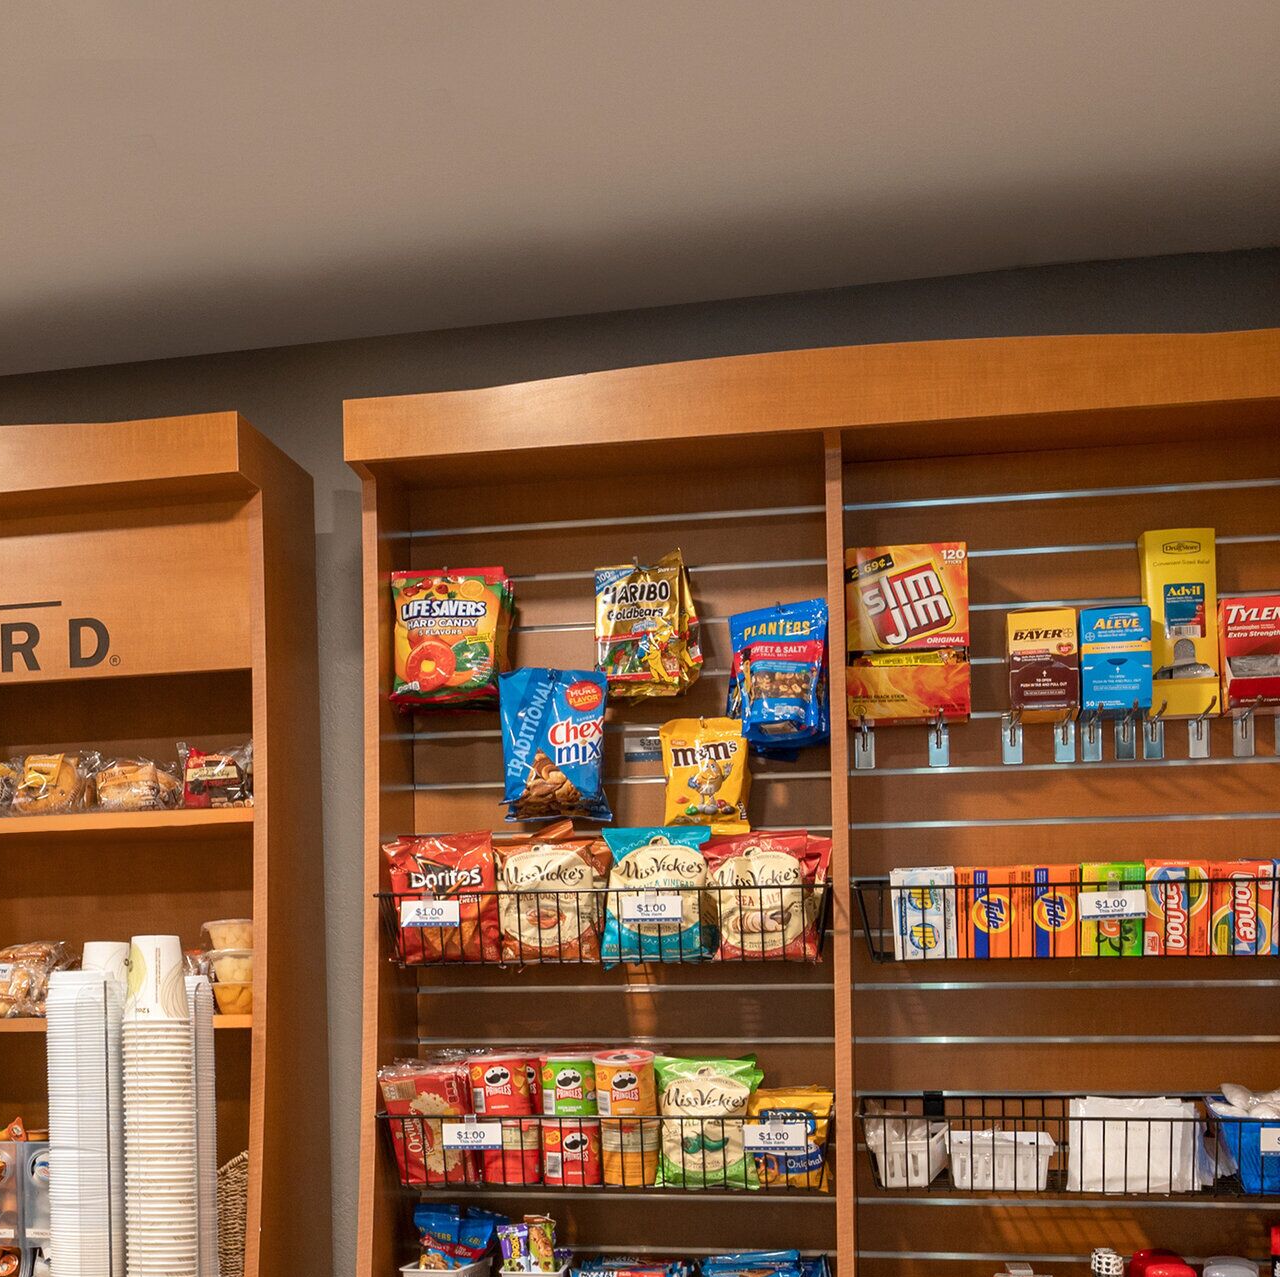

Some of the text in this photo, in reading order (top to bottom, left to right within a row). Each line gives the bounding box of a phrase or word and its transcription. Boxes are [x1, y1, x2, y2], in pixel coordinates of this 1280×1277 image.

[941, 549, 965, 560] 120
[604, 580, 671, 605] HARIBO
[1167, 585, 1201, 596] Advil
[607, 607, 665, 621] Goldbears
[407, 619, 478, 629] HARD CANDY
[1093, 618, 1140, 630] ALEVE
[744, 621, 811, 641] PLANTERS
[1013, 629, 1063, 641] BAYER
[1227, 630, 1280, 639] Extra Strength
[783, 644, 808, 653] SALTY
[569, 695, 600, 705] FLAVOR
[507, 681, 554, 778] TRADITIONAL
[549, 716, 605, 746] Chex
[556, 737, 603, 766] mix
[671, 741, 738, 767] m&m's
[620, 854, 705, 880] Miss Vickie's
[410, 868, 482, 888] Doritos
[717, 863, 800, 887] Miss Vickie's
[734, 894, 755, 906] SEA
[1095, 898, 1128, 909] $1.00
[415, 907, 444, 917] $1.00
[636, 903, 666, 914] $1.00
[979, 897, 1004, 930] Tide
[1041, 895, 1066, 928] Tide
[485, 1085, 512, 1097] PRINGLES
[556, 1088, 583, 1099] PRINGLES
[612, 1089, 639, 1101] PRINGLES
[663, 1087, 748, 1108] Miss Vickie's
[456, 1130, 486, 1140] $1.00
[758, 1131, 789, 1141] $1.00
[786, 1153, 823, 1169] Original
